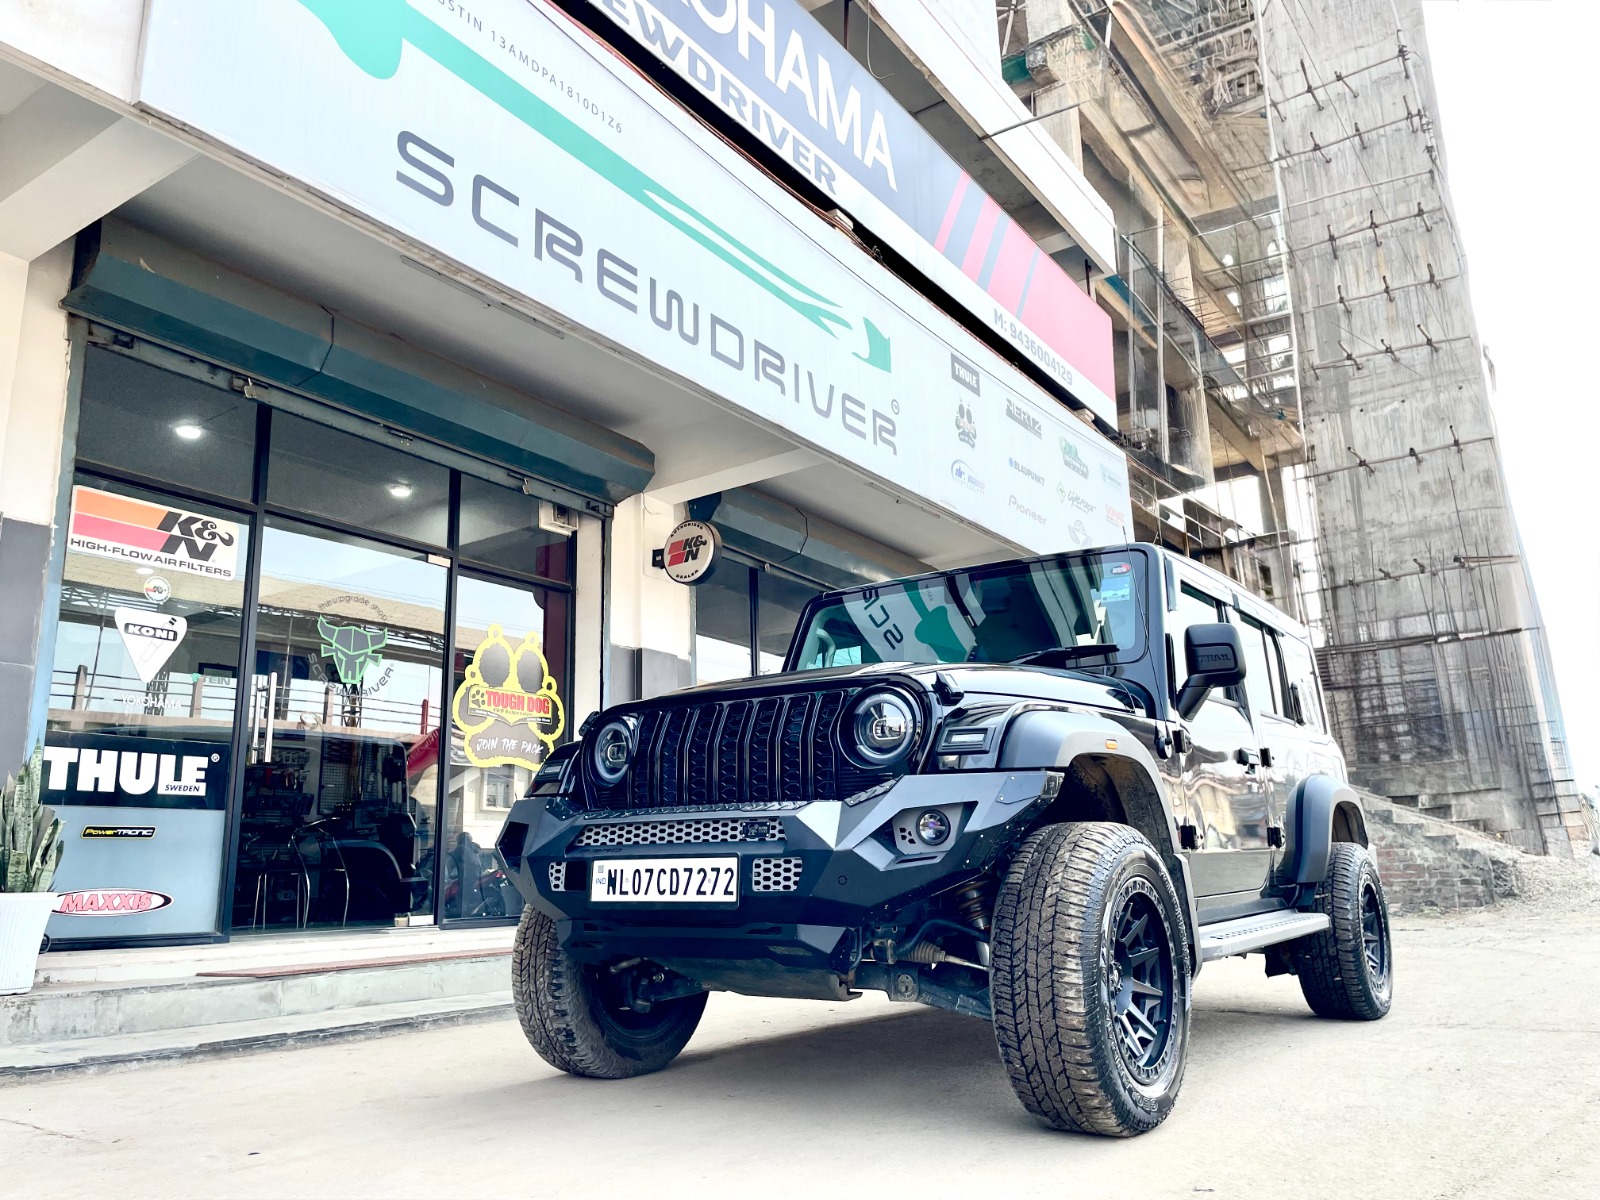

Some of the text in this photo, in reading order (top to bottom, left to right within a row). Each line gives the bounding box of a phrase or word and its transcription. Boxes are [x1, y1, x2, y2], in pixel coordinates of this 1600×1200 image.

[491, 30, 622, 133] 13AMDPA1810D1Z6
[683, 0, 898, 192] OHAMA
[396, 131, 897, 456] SCREWDRIVER
[994, 308, 1072, 386] M: 9436004129
[954, 362, 978, 388] THULE
[1014, 460, 1045, 486] BLAUPUNKT
[1008, 494, 1047, 525] Pioneer
[70, 537, 232, 577] HIGH-FLOW AIR FILTERS
[675, 569, 699, 579] DEALER
[127, 624, 175, 640] KONI
[121, 694, 182, 710] YOKOHAMA
[485, 690, 550, 714] TOUGH DOG
[476, 737, 544, 757] JOIN THE PACK
[42, 746, 209, 796] THULE
[165, 784, 200, 792] SWEDEN
[596, 867, 734, 895] IND NL07CD7272
[60, 893, 153, 912] MAXXIS
